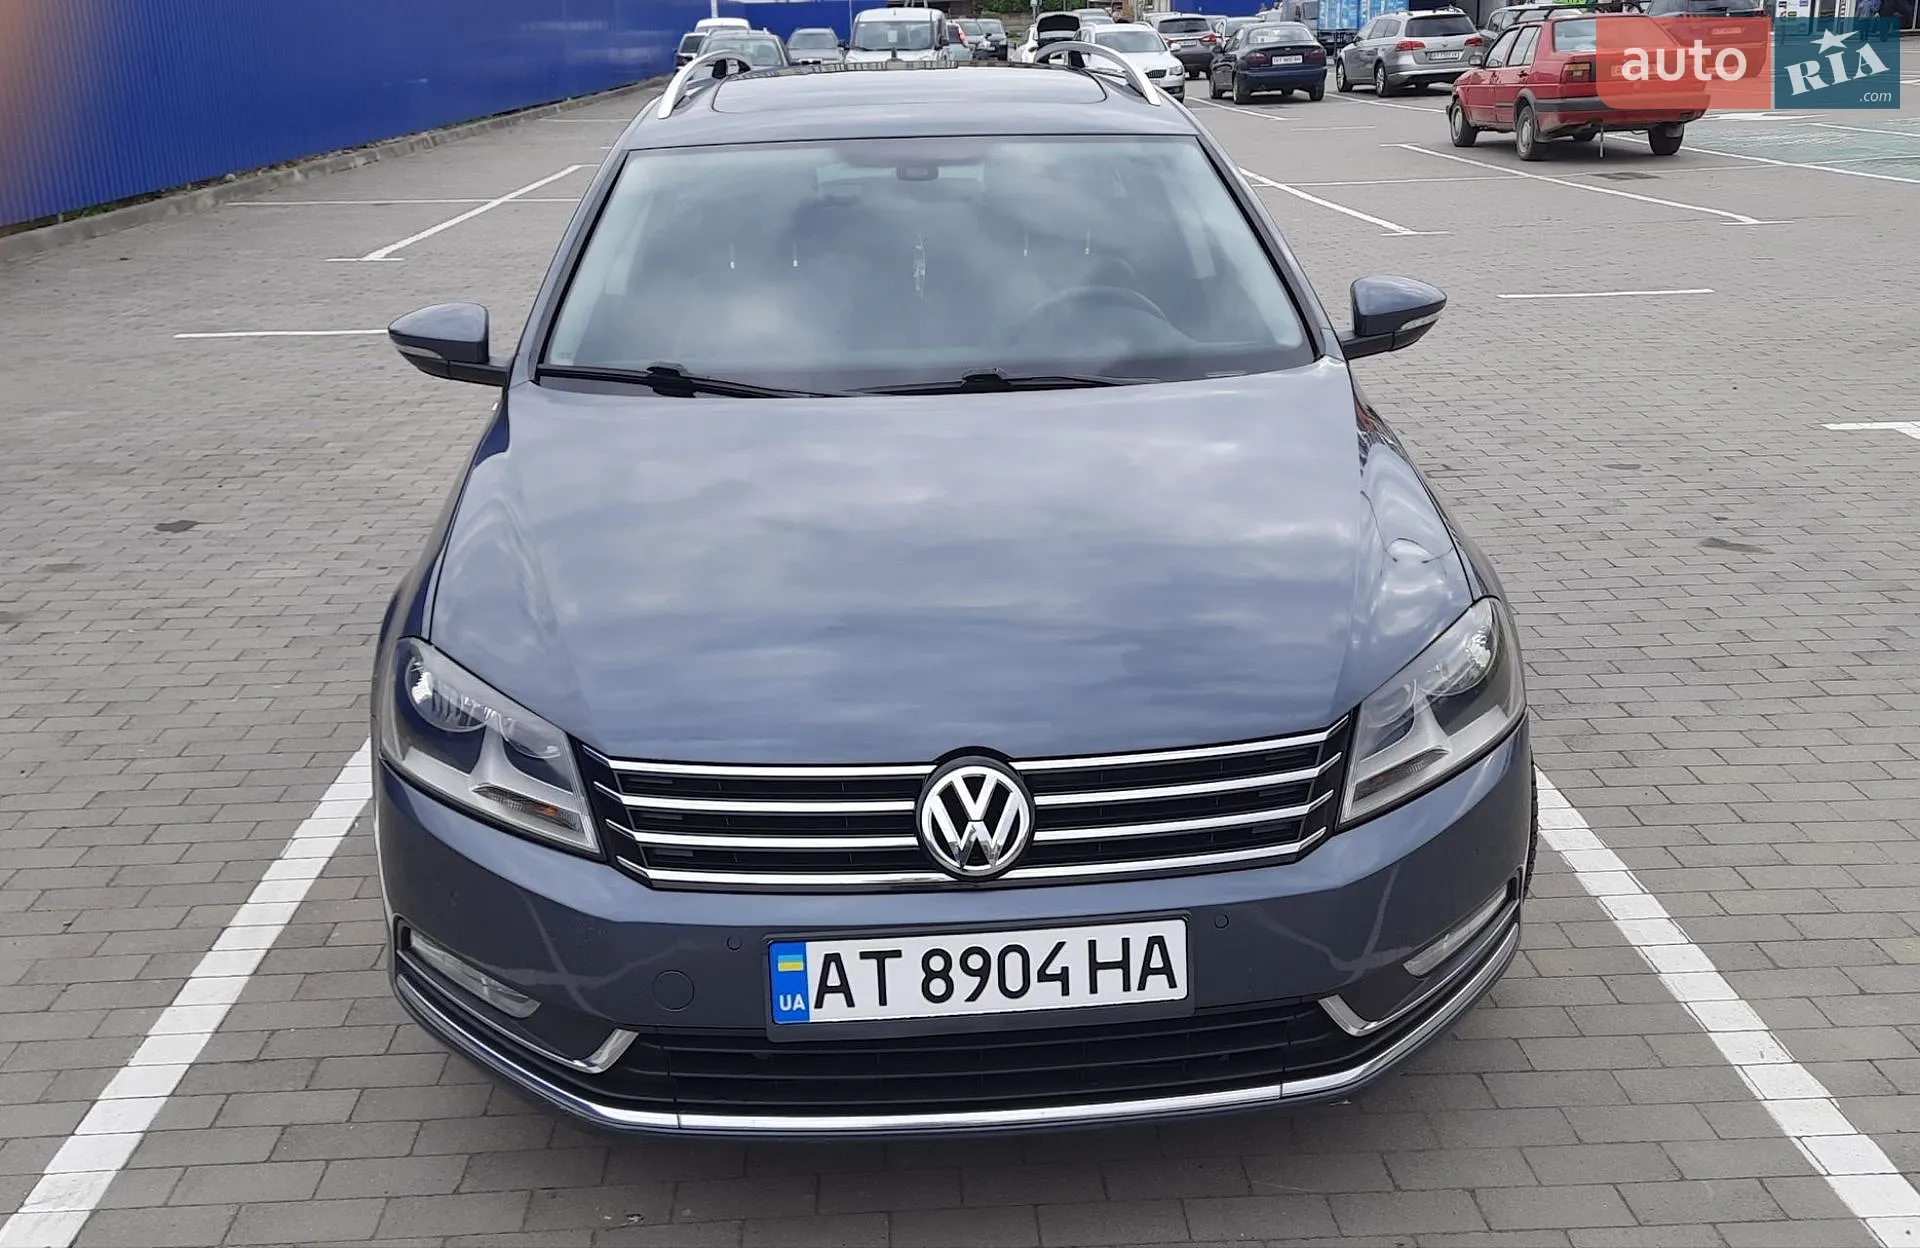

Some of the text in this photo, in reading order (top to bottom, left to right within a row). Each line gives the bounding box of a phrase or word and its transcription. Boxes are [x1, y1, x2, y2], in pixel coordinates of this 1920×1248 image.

[814, 935, 1178, 1009] AT 8904 HA
[779, 993, 806, 1011] UA
